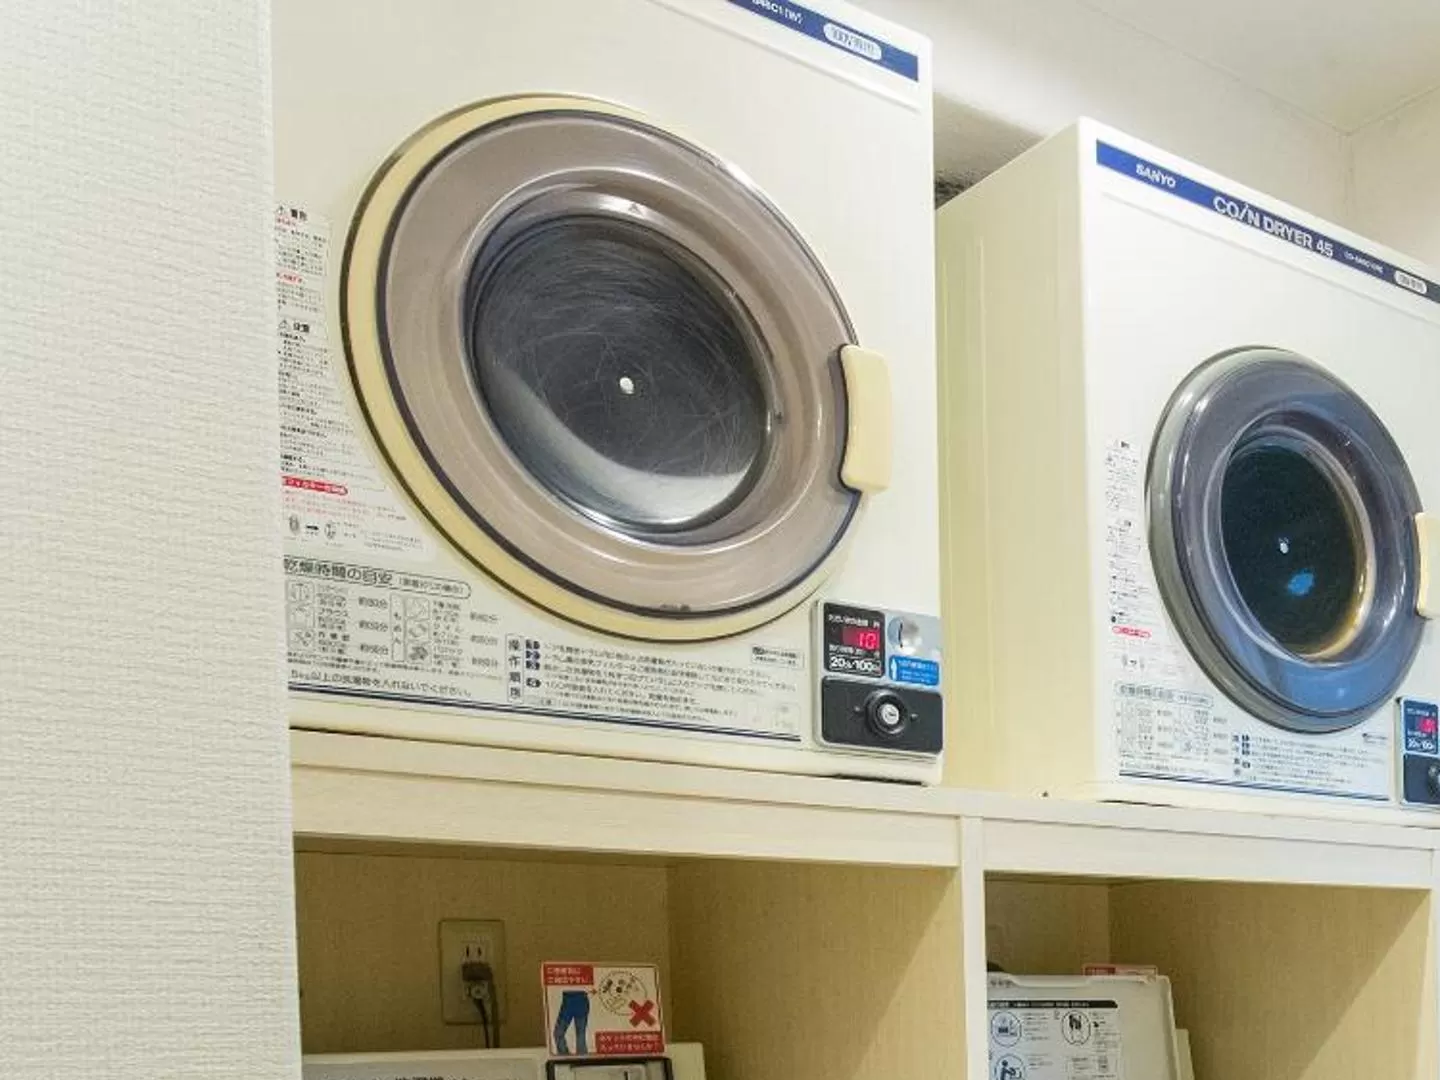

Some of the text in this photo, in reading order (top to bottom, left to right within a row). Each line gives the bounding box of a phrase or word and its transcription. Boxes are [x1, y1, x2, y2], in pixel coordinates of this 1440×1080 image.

[1135, 163, 1176, 189] SANYO
[1263, 215, 1313, 250] DRYER
[1316, 239, 1334, 259] 45
